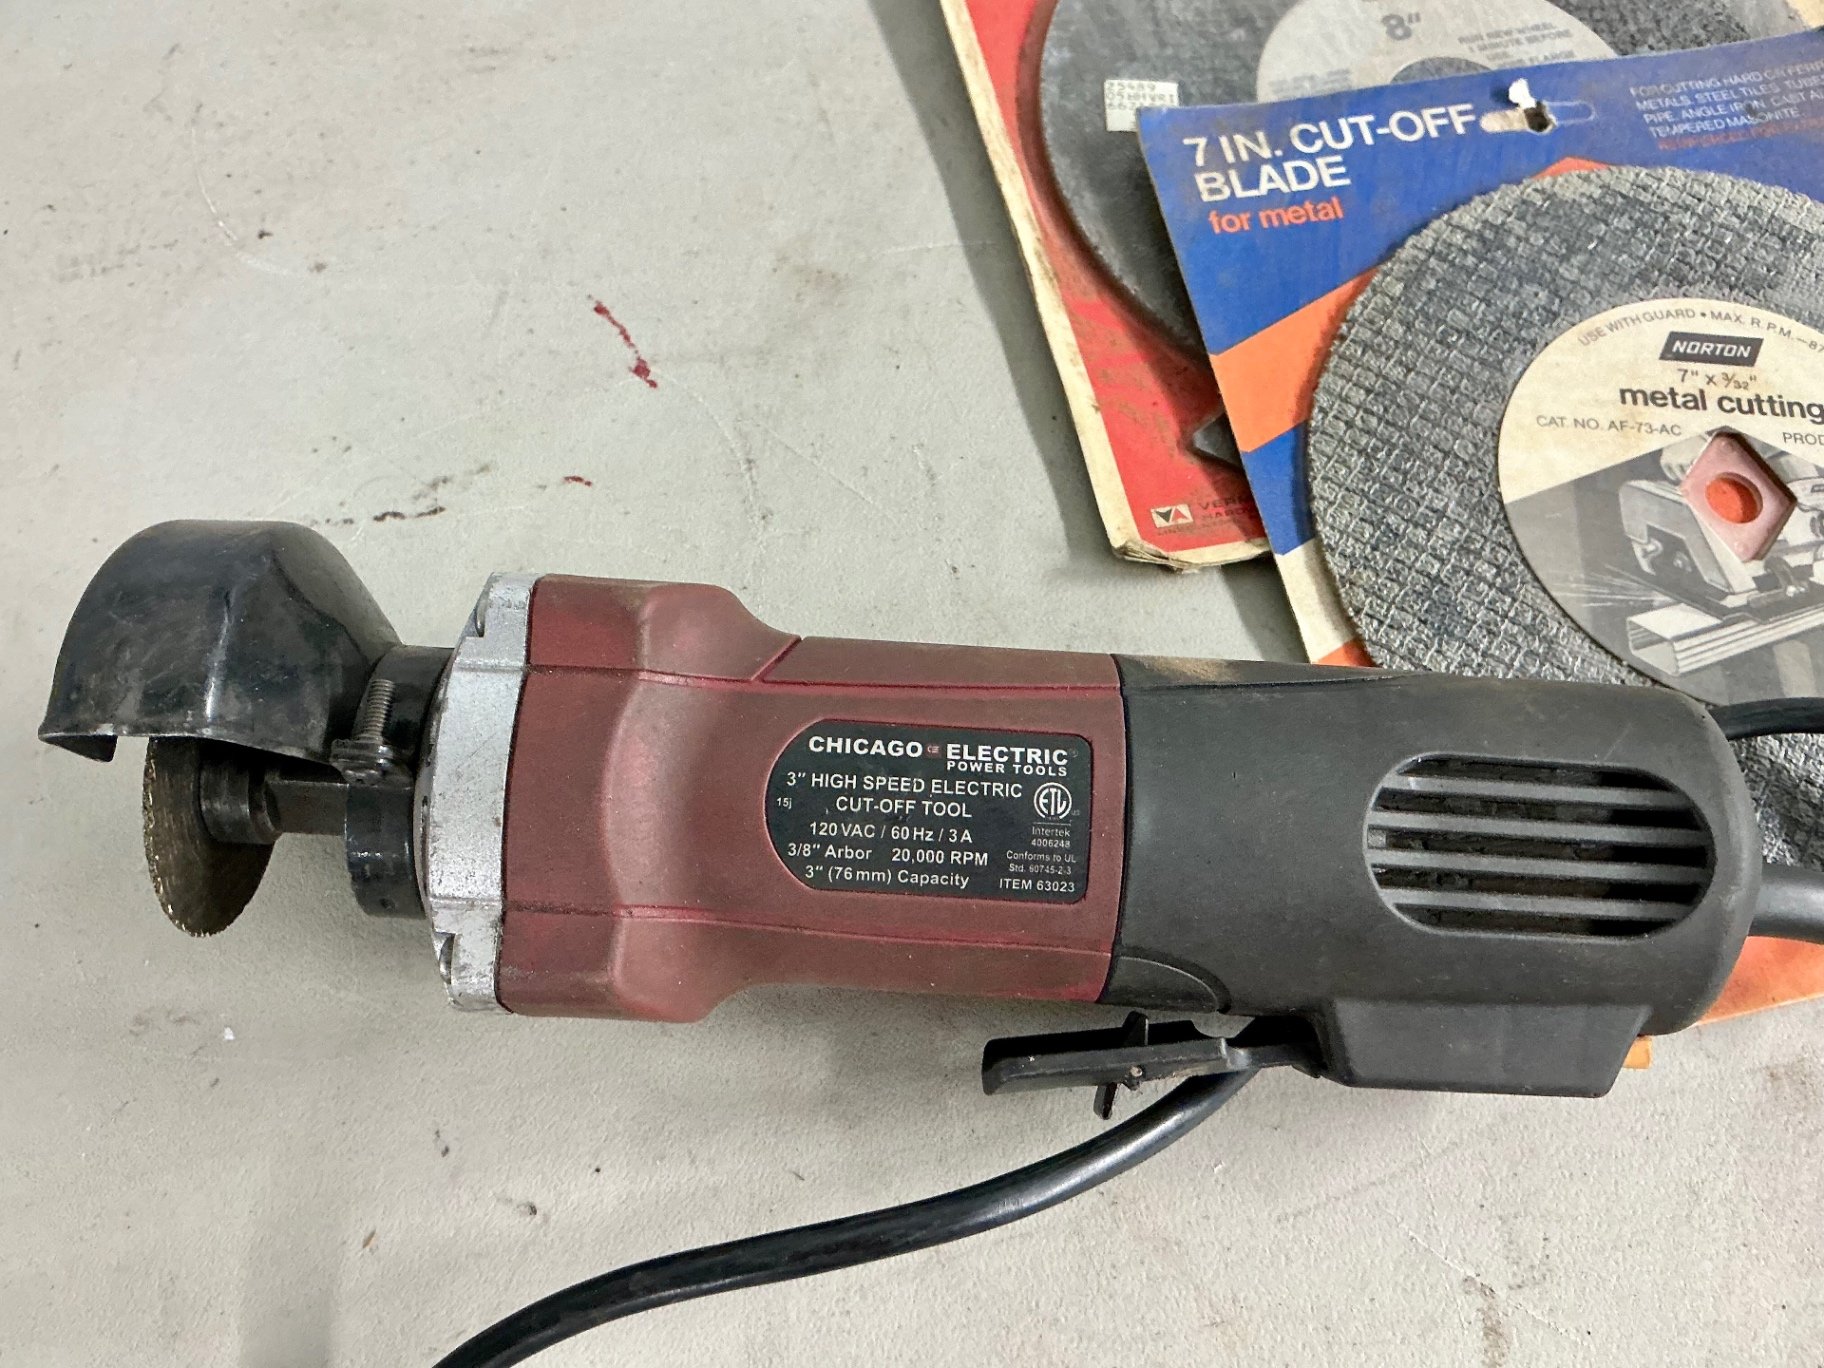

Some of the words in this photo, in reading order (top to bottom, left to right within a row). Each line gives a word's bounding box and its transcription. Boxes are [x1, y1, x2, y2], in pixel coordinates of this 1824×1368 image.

[1381, 12, 1421, 41] 8"
[1182, 135, 1208, 166] 7
[1220, 131, 1283, 164] IN.
[1290, 103, 1476, 153] CUT-OFF
[1194, 155, 1351, 202] BLADE
[1209, 209, 1253, 234] for
[1259, 196, 1344, 229] metal
[1577, 327, 1606, 346] USE
[1606, 313, 1643, 333] WITH
[1642, 308, 1696, 322] GUARD
[1672, 340, 1751, 358] NORTON
[1677, 368, 1700, 384] 7"
[1619, 387, 1707, 411] metal
[1717, 393, 1824, 426] cutting
[1608, 419, 1682, 436] AF-73-AC
[808, 736, 923, 758] CHICAGO
[946, 743, 1068, 765] ELECTRIC
[946, 761, 1005, 774] POWER
[1013, 764, 1067, 777] TOOLS
[786, 772, 806, 787] 3"
[811, 773, 857, 789] HIGH
[863, 775, 925, 793] SPEED
[931, 779, 1022, 798] ELECTRIC
[776, 797, 792, 809] 15j
[836, 796, 916, 814] CUT-OFF
[922, 801, 972, 818] TOOL
[810, 822, 837, 837] 120
[841, 824, 876, 838] VAC
[880, 825, 886, 839] /
[891, 826, 910, 840] 60
[913, 827, 934, 842] Hz
[938, 828, 943, 842] /
[949, 829, 958, 843] 3
[960, 829, 973, 843] A
[1031, 826, 1071, 837] Intertek
[1031, 838, 1071, 848] 4006248
[787, 843, 821, 857] 3/8"
[824, 844, 872, 860] Arbor
[891, 848, 944, 864] 20,000
[950, 851, 989, 866] RPM
[1006, 850, 1051, 862] Conforms
[1053, 854, 1062, 862] to
[1064, 854, 1077, 864] UL
[805, 865, 823, 879] 3"
[828, 866, 853, 883] (76
[856, 869, 892, 885] mm)
[897, 870, 970, 889] Capacity
[1009, 863, 1026, 873] Std.
[999, 878, 1032, 890] ITEM
[1036, 880, 1075, 892] 63023
